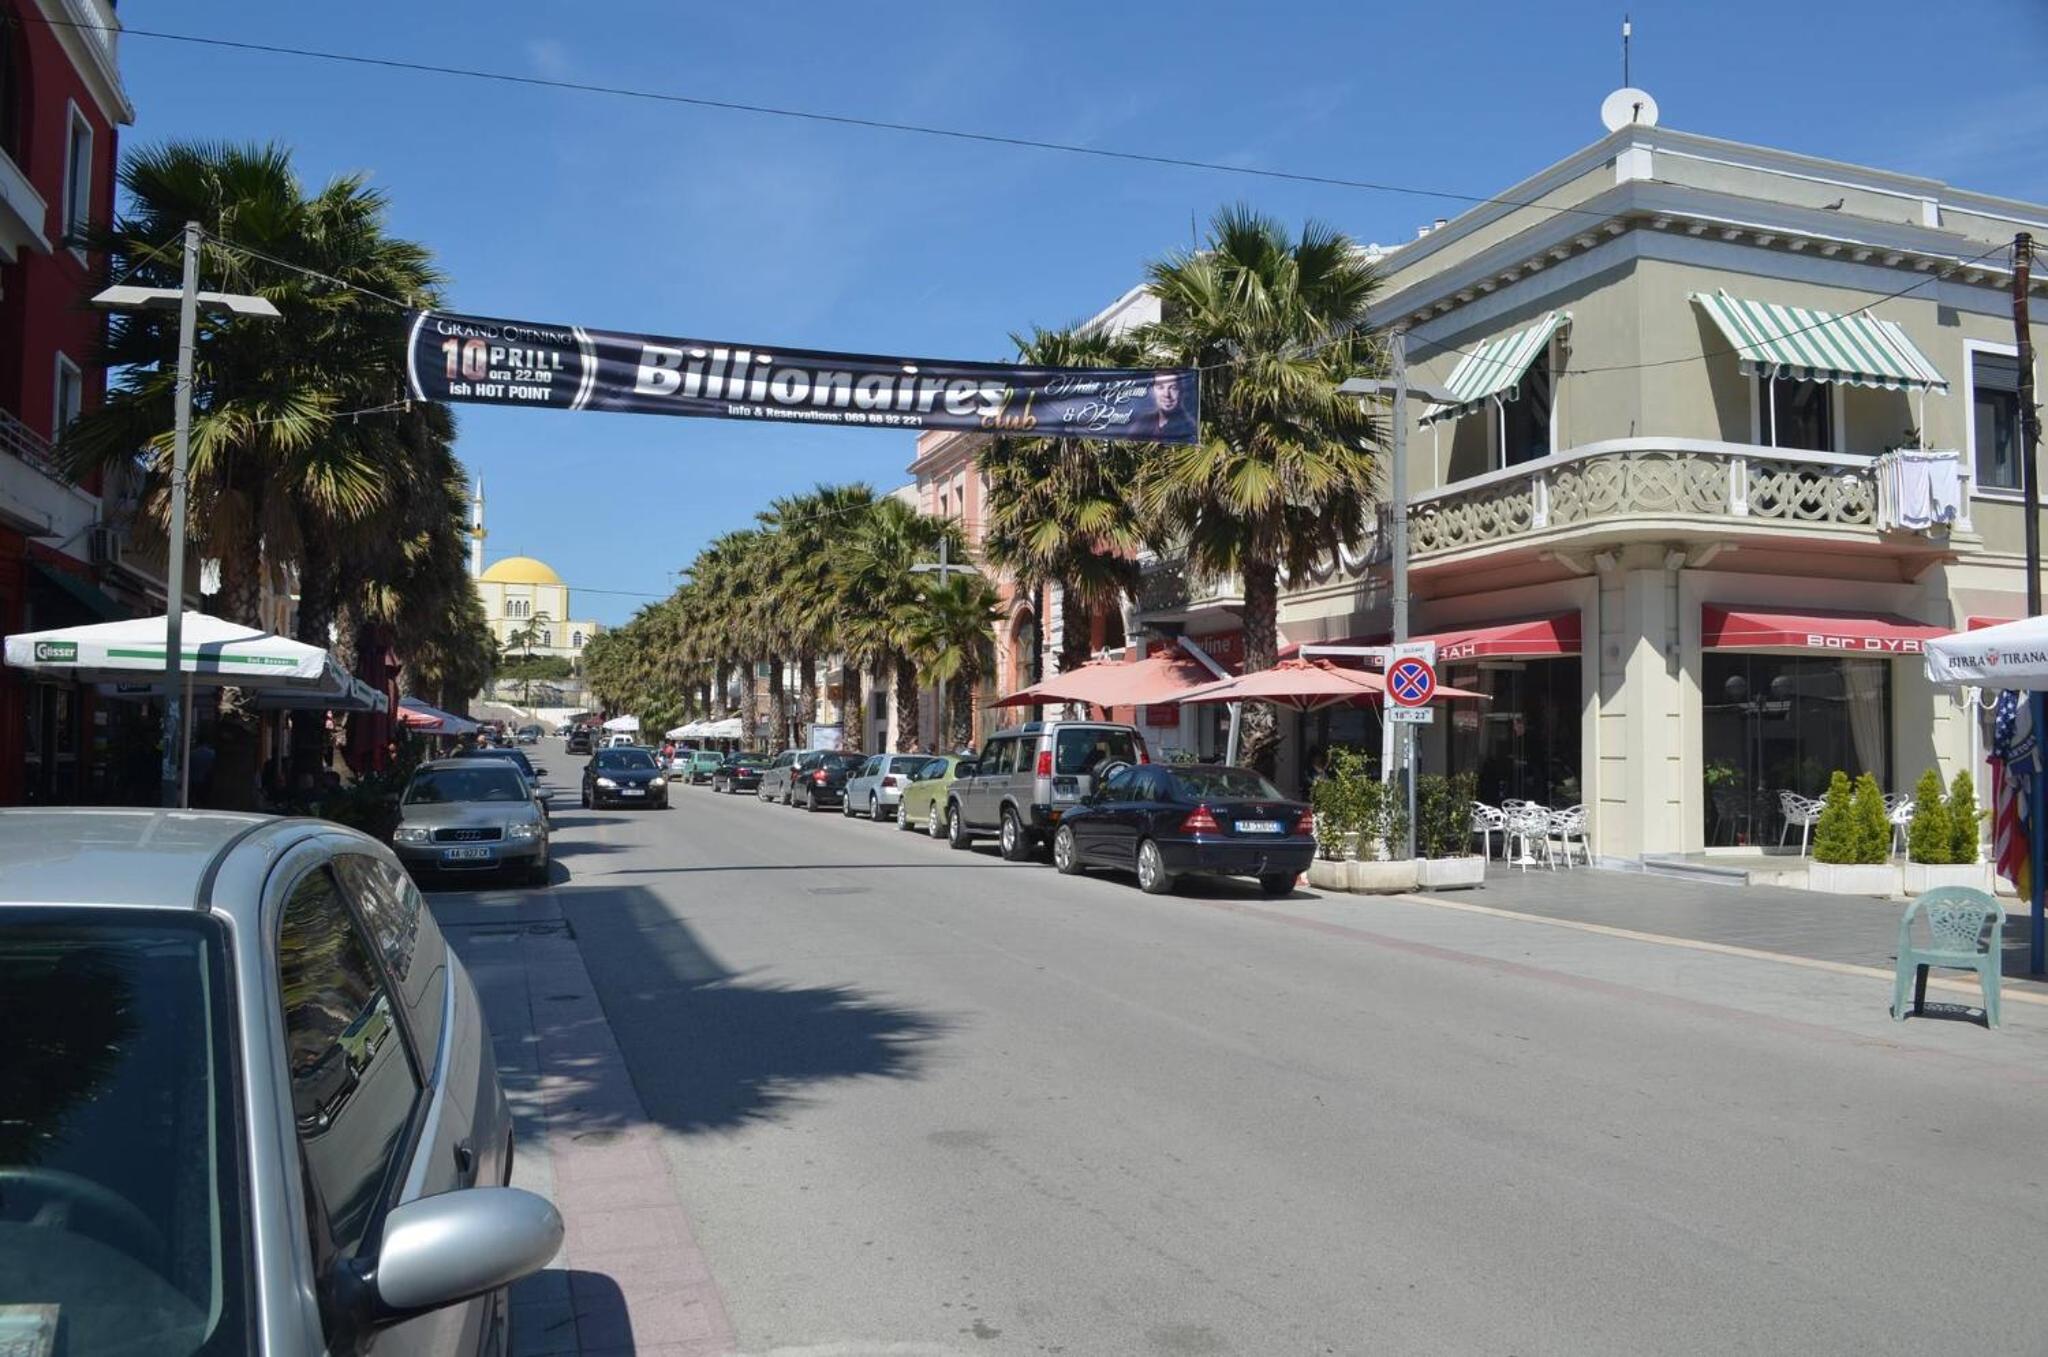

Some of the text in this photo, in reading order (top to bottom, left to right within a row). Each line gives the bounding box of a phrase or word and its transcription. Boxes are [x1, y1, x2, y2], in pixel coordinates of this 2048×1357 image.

[442, 338, 564, 380] 10 PRILL
[489, 370, 552, 383] ora 22.00
[634, 345, 1007, 417] Billionaires
[450, 382, 551, 400] ish HOT POINT
[728, 405, 750, 416] Info
[754, 407, 763, 417] &
[902, 416, 922, 426] 221
[1807, 634, 1855, 648] Bar
[1948, 651, 2047, 668] BIRRA TIRANA
